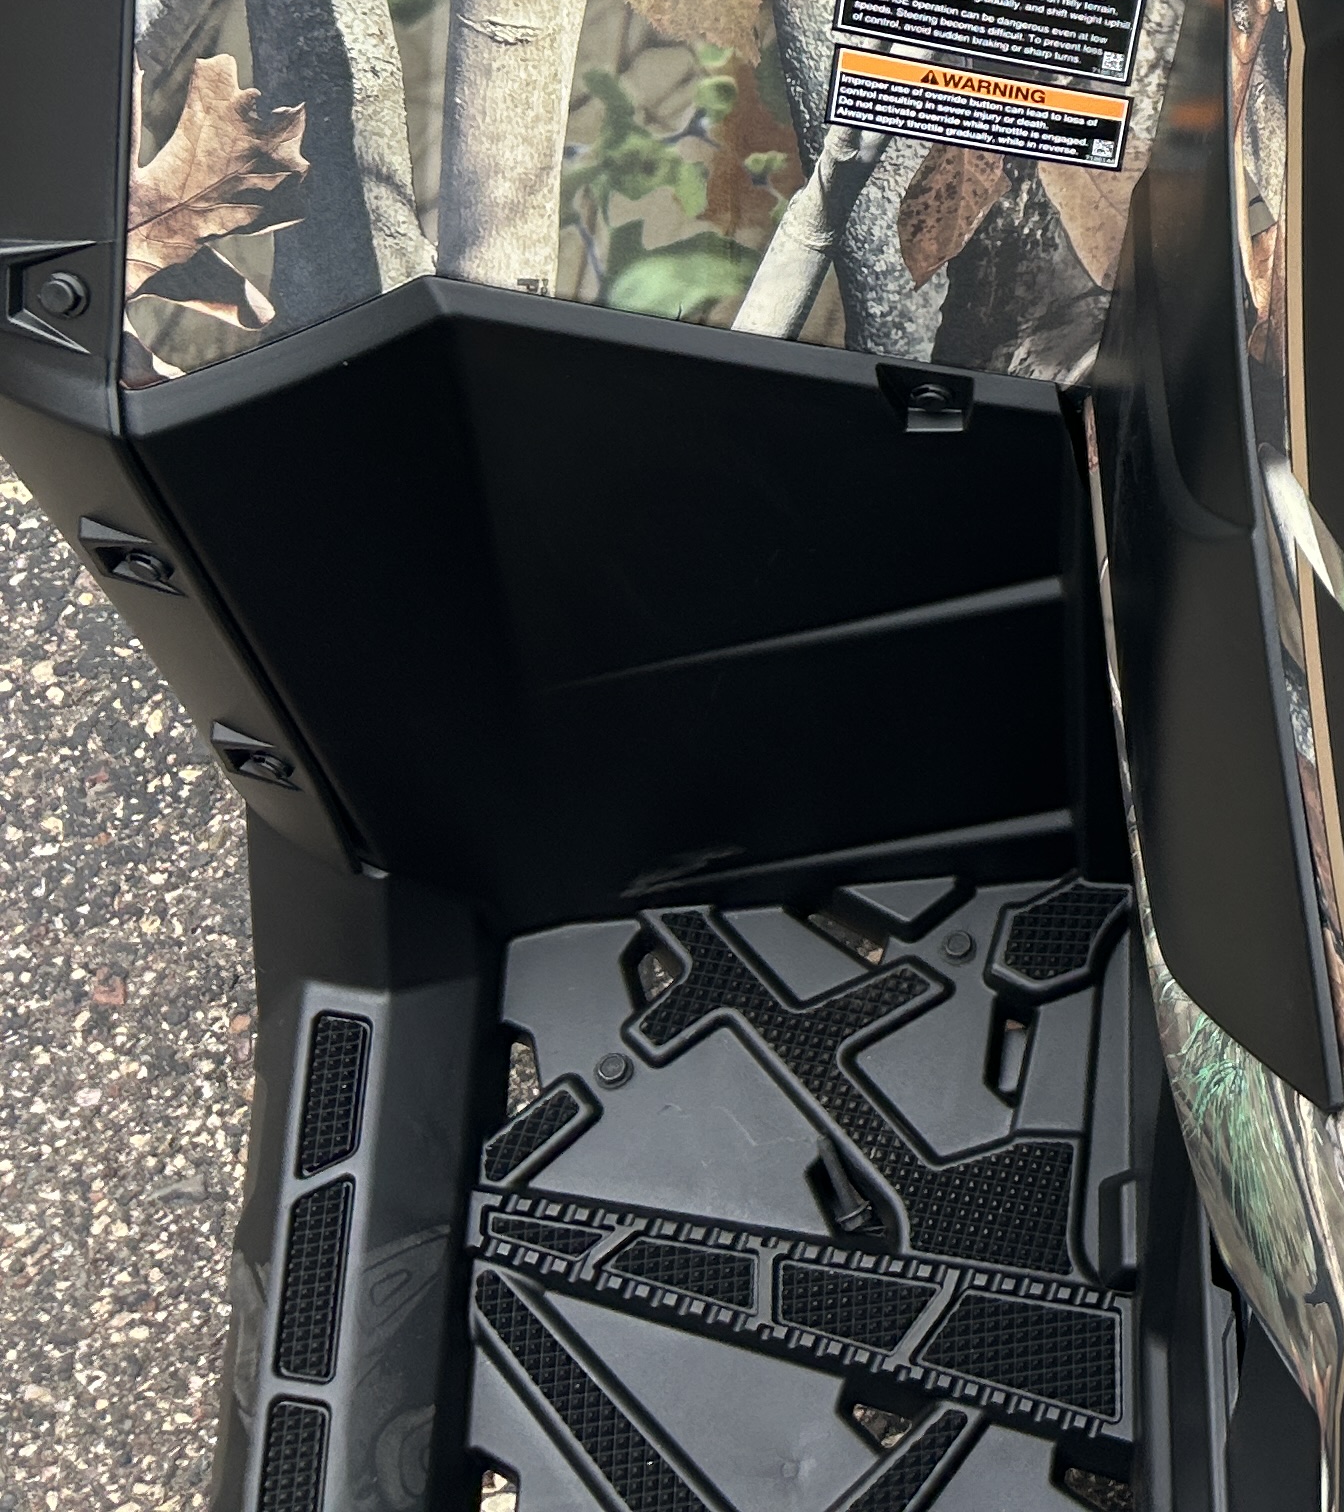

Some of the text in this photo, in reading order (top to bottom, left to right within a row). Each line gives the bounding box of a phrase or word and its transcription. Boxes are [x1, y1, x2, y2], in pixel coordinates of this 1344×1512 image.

[911, 0, 959, 16] operation
[960, 9, 980, 20] can
[981, 12, 995, 23] be
[996, 16, 1050, 34] dangerous
[1051, 27, 1076, 38] even
[1077, 31, 1088, 40] at
[1090, 33, 1108, 44] low
[1024, 2, 1045, 13] and
[1046, 6, 1068, 18] shift
[1068, 10, 1102, 25] weight
[841, 74, 1098, 127] Improper use of override button can lead to loss of
[941, 73, 1046, 104] WARNING
